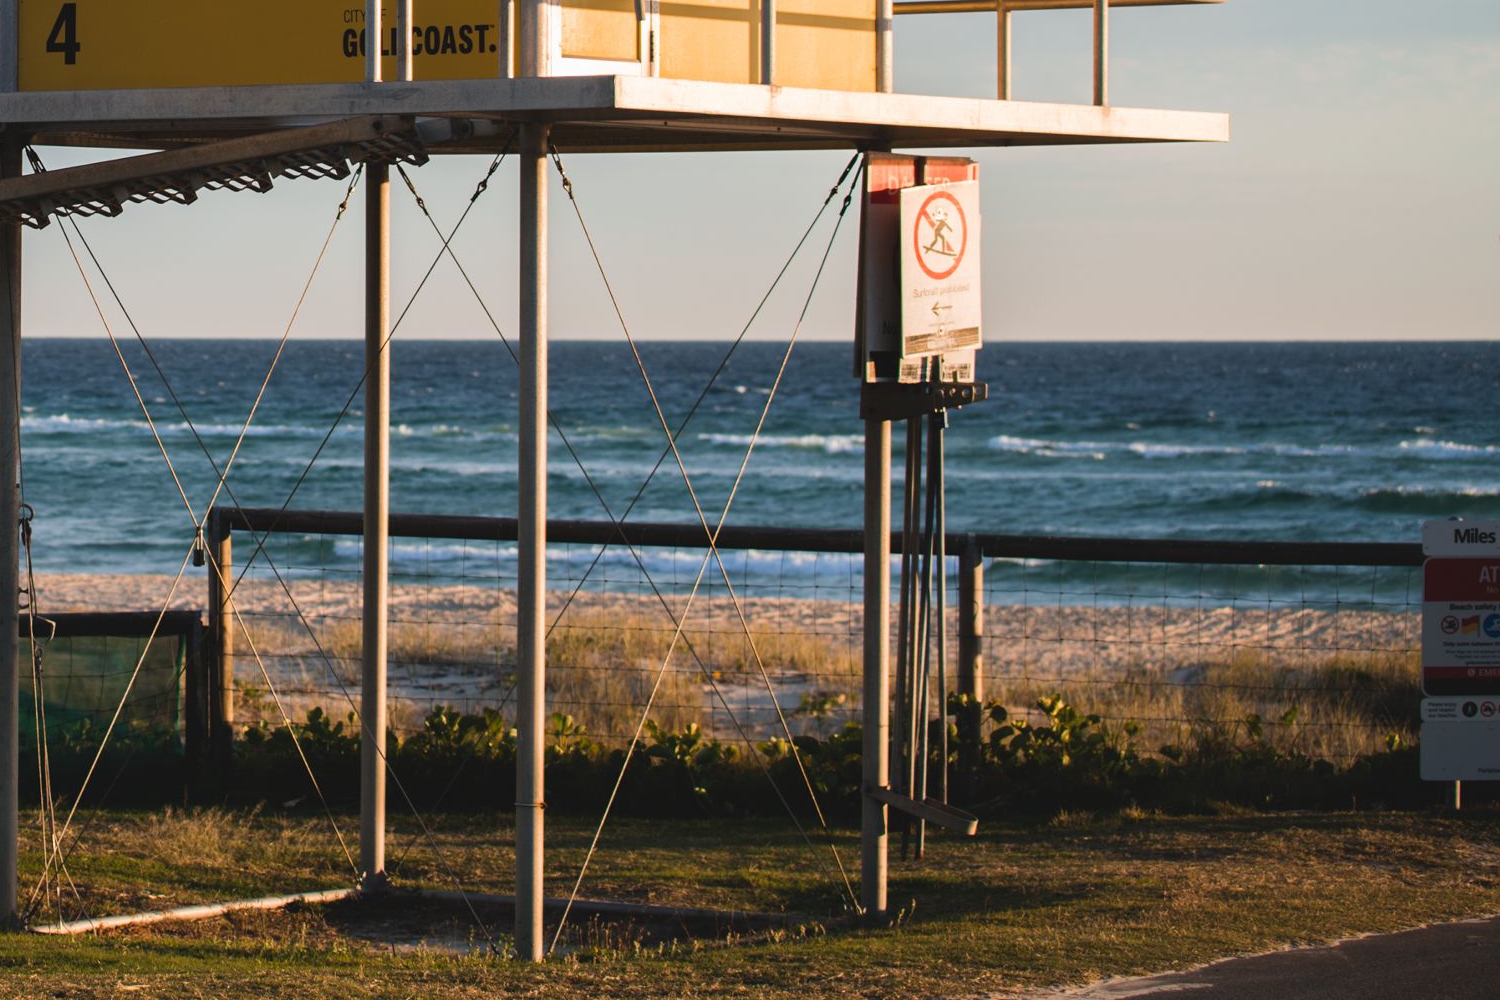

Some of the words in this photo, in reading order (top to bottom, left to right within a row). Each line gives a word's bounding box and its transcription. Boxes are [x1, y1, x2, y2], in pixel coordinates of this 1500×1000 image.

[343, 9, 366, 24] CITY
[45, 3, 81, 65] 4
[1454, 528, 1496, 544] Miles
